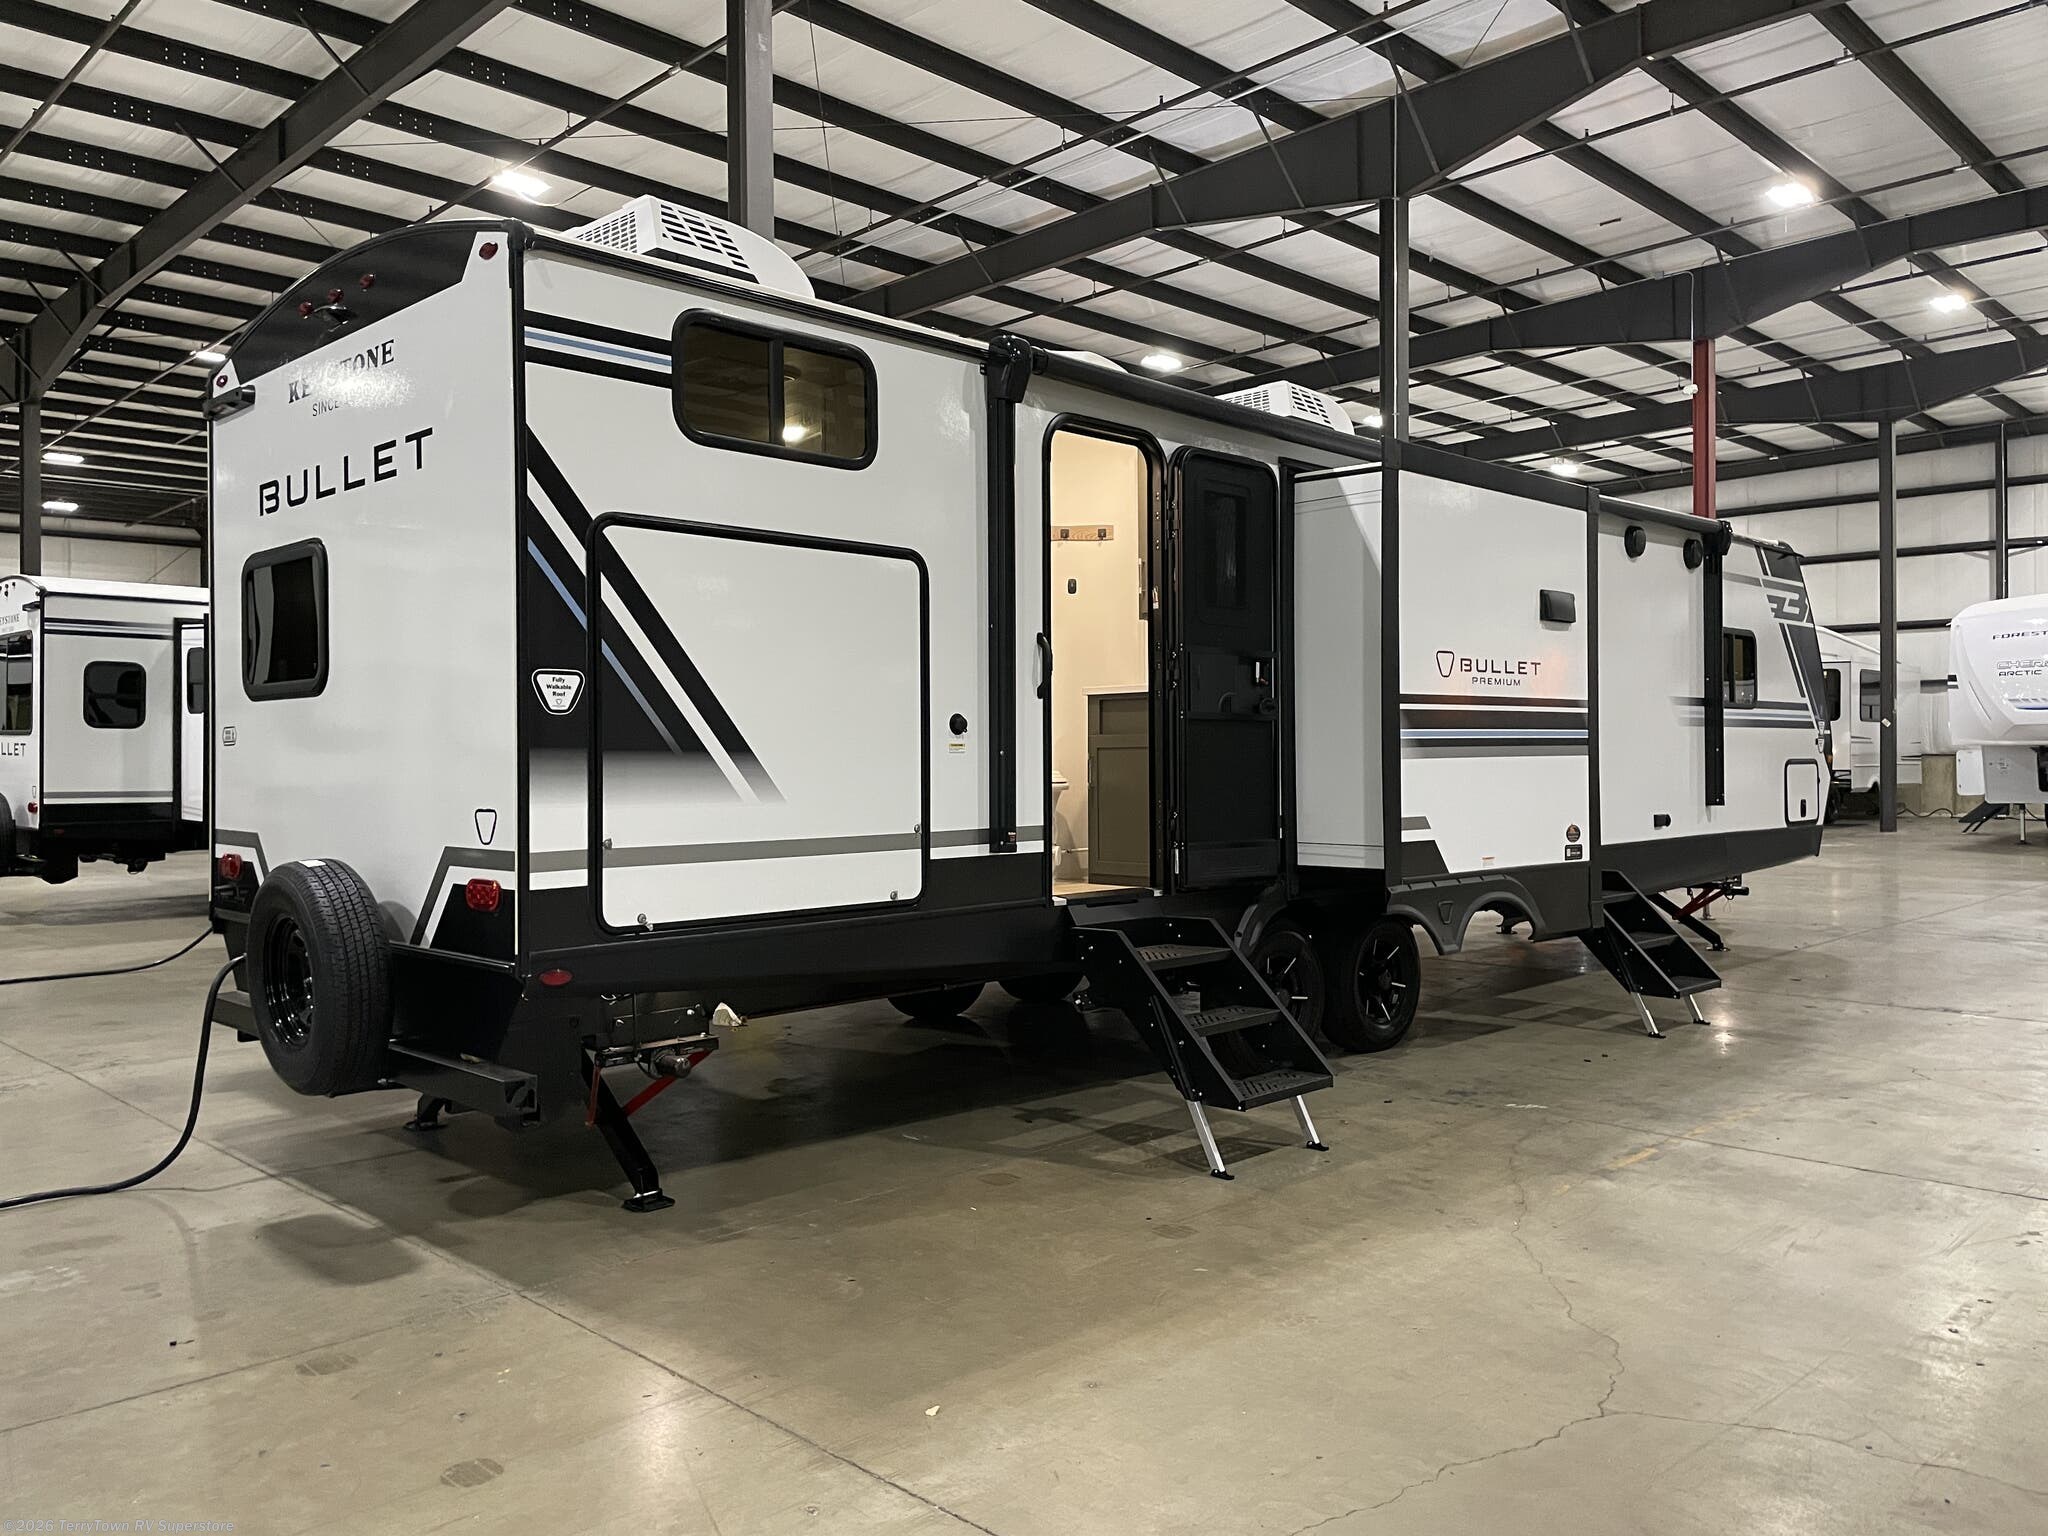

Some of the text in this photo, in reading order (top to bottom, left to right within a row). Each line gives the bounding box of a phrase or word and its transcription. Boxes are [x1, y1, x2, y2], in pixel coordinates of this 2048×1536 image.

[259, 427, 433, 517] BULLET
[1460, 657, 1542, 676] BULLET
[1998, 669, 2042, 677] ARCTIC
[1471, 676, 1521, 687] PREMIUM
